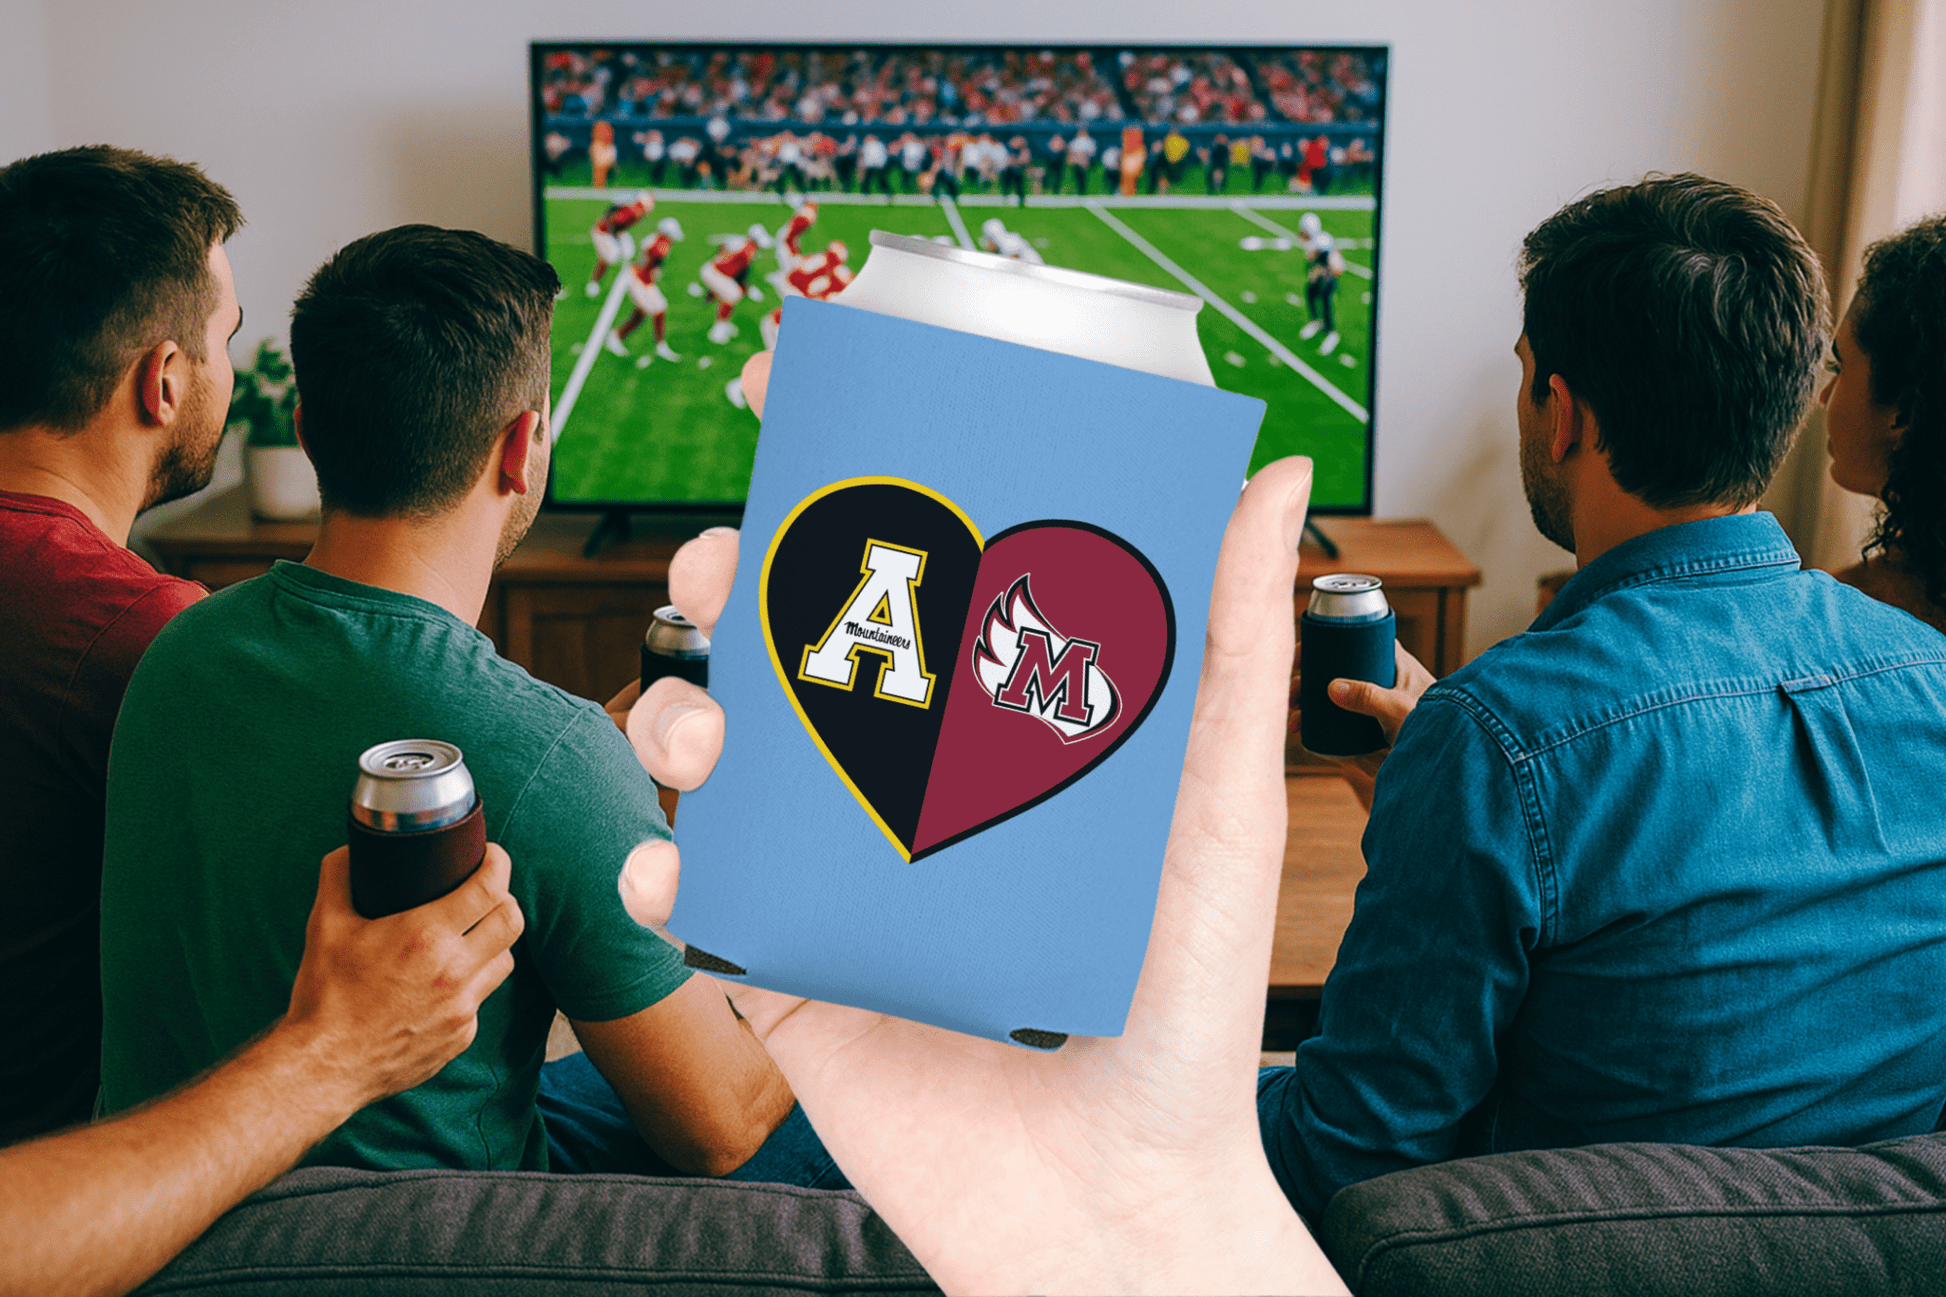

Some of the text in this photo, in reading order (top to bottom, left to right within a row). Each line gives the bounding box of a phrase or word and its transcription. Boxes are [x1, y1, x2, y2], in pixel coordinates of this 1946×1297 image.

[798, 538, 936, 709] A
[844, 621, 911, 650] Mountaineers
[993, 626, 1100, 727] M
